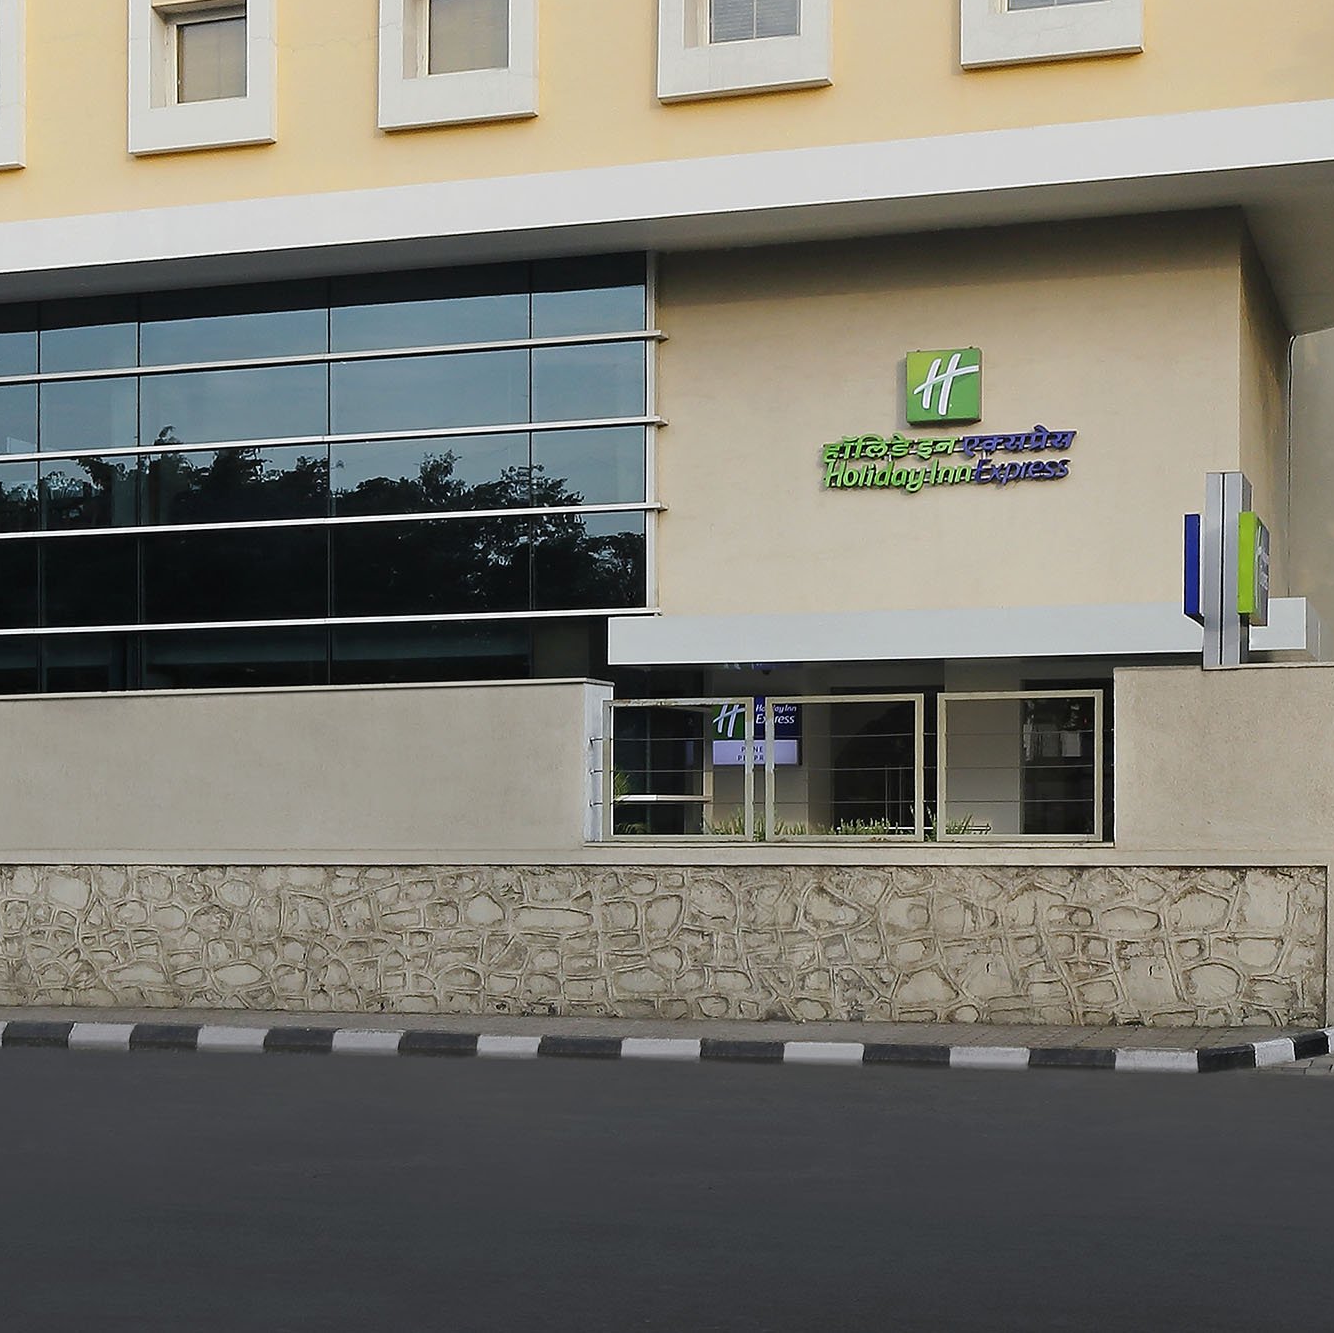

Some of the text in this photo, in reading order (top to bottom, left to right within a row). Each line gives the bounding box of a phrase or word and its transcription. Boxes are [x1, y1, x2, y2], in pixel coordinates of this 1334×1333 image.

[822, 424, 1078, 463] हॉलिडे इन एक्सप्रेस
[824, 458, 1072, 493] Holiday Inn Express
[784, 703, 798, 712] Inn
[755, 713, 795, 725] Exress
[740, 745, 764, 753] PNE
